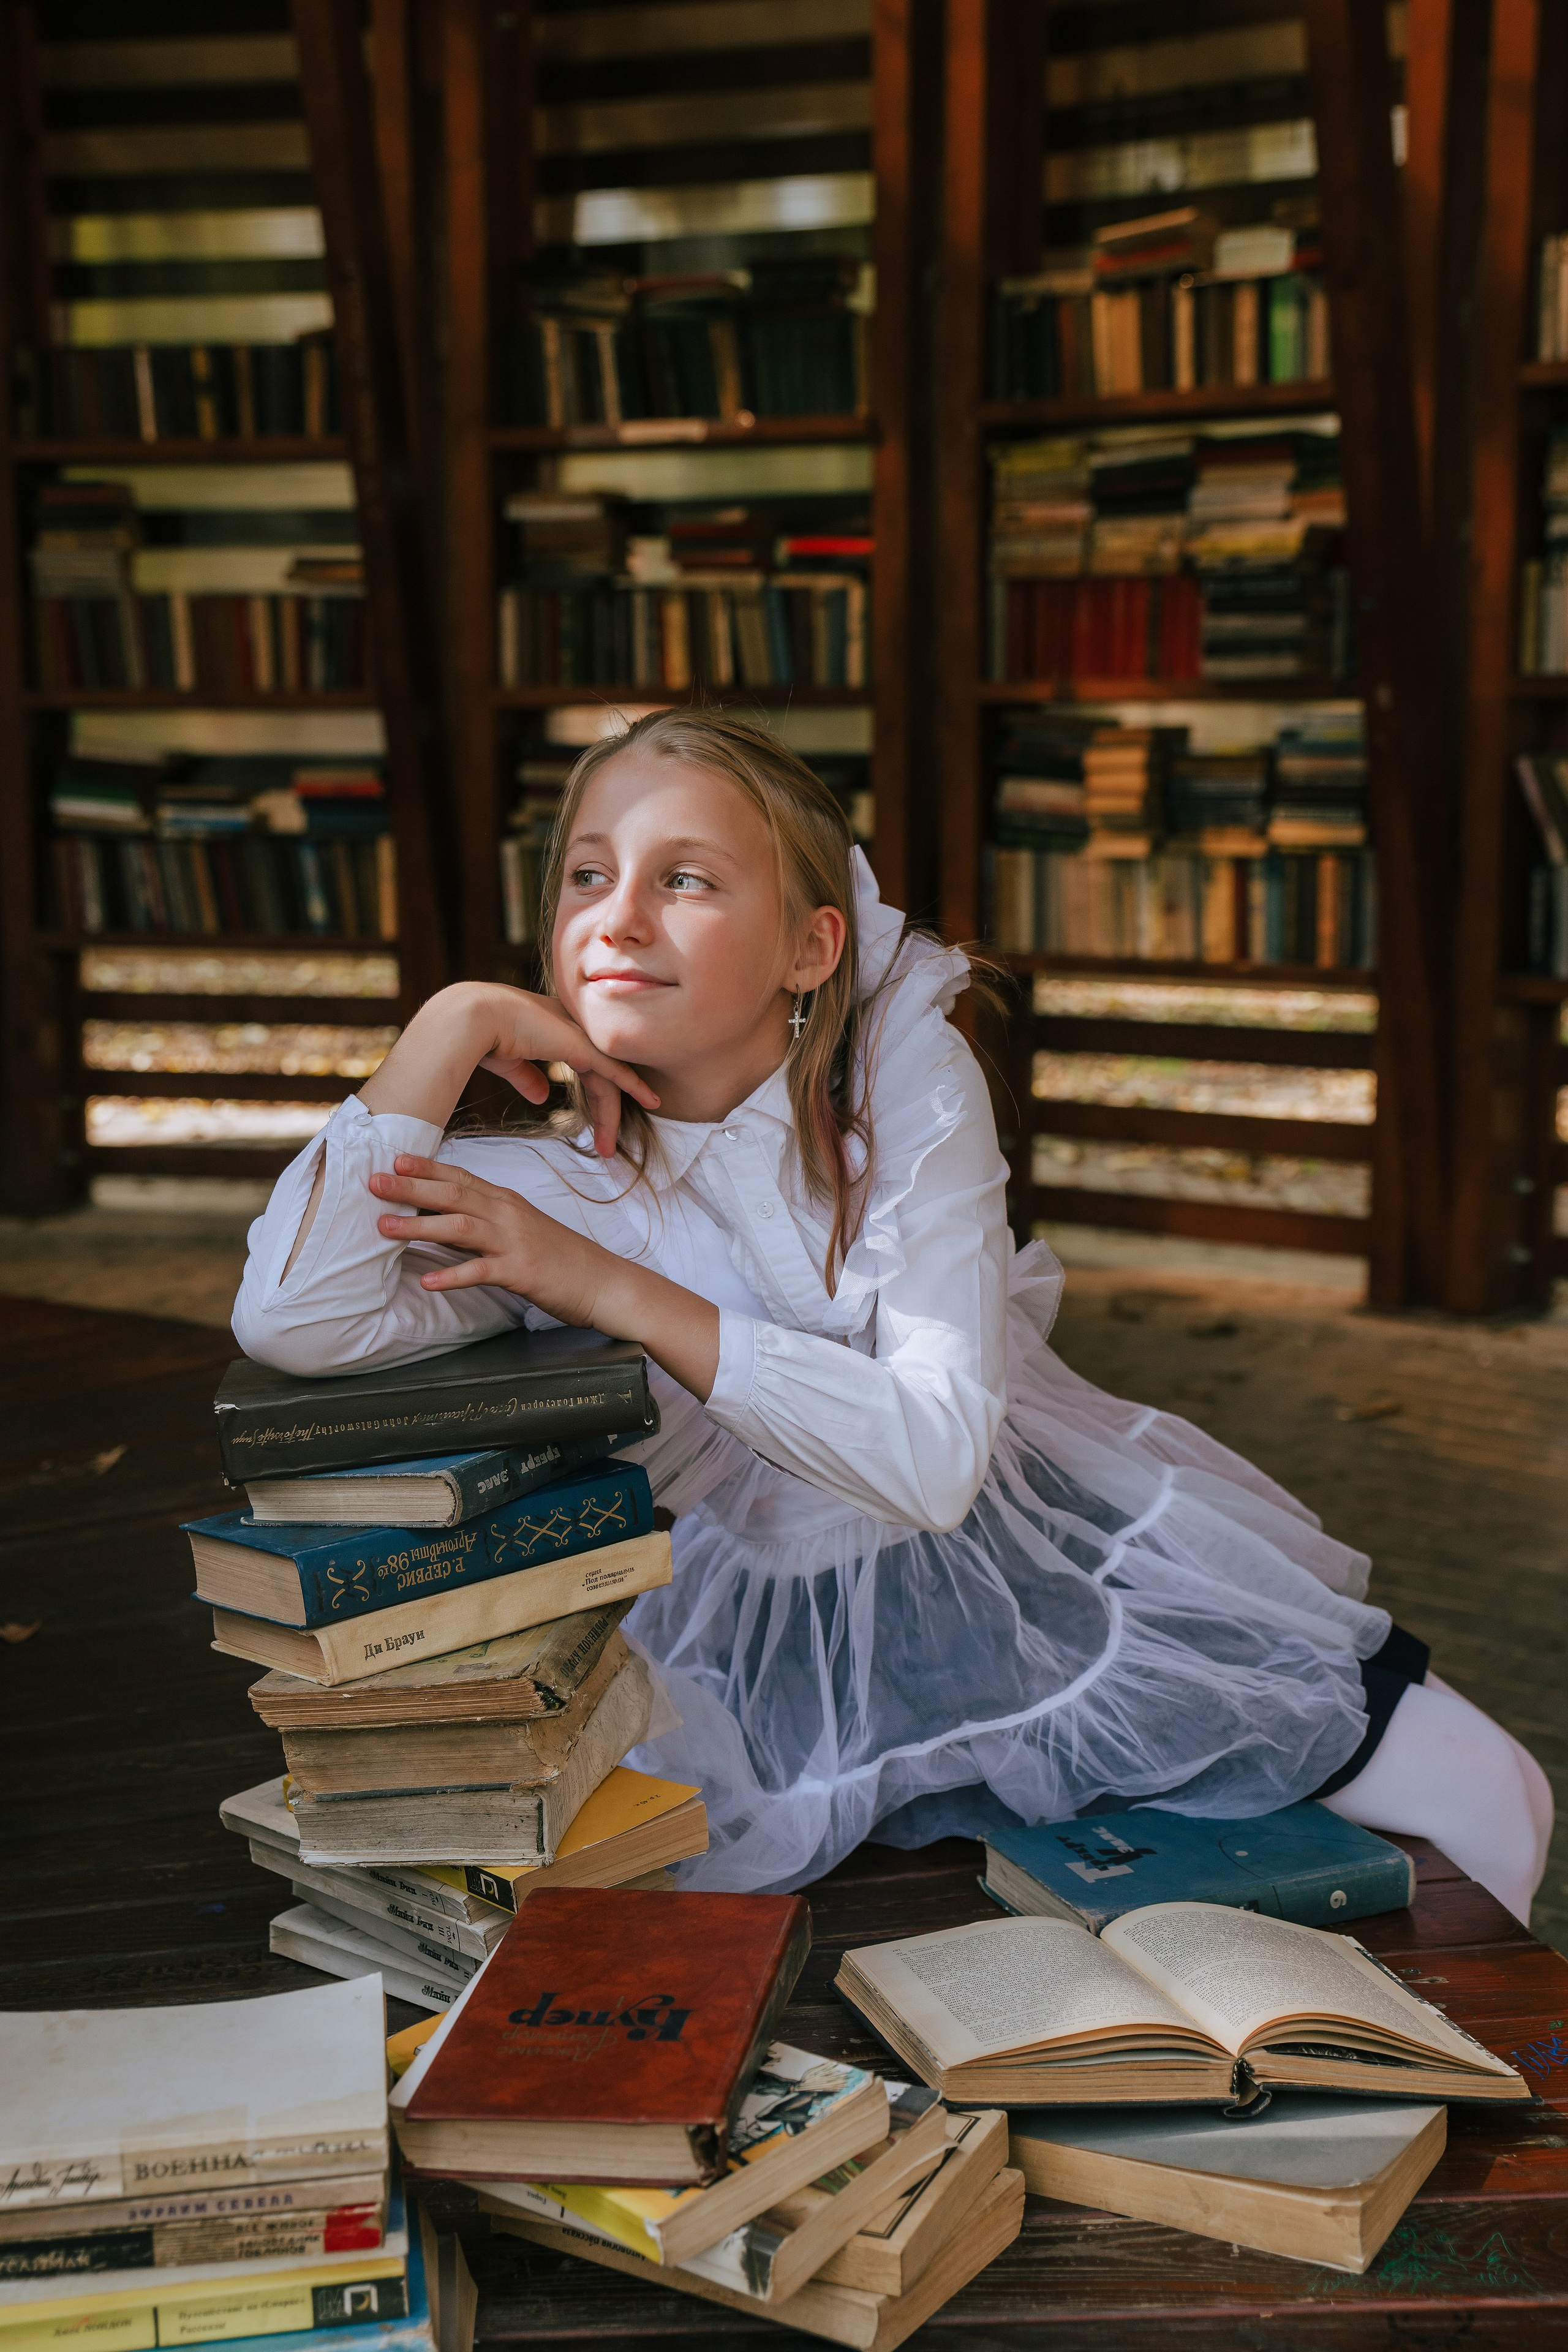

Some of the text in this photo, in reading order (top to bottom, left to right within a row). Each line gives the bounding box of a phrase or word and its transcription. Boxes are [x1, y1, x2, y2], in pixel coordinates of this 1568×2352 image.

[297, 1422, 315, 1441] The
[314, 1415, 409, 1436] John Galsworthy
[409, 1529, 478, 1562] Аргонавты
[397, 1561, 451, 1591] СЕРВИС
[586, 1567, 602, 1578] серия
[363, 1629, 426, 1662] Ди Браун
[387, 1904, 415, 1923] Майн
[507, 1992, 699, 2041] Купер
